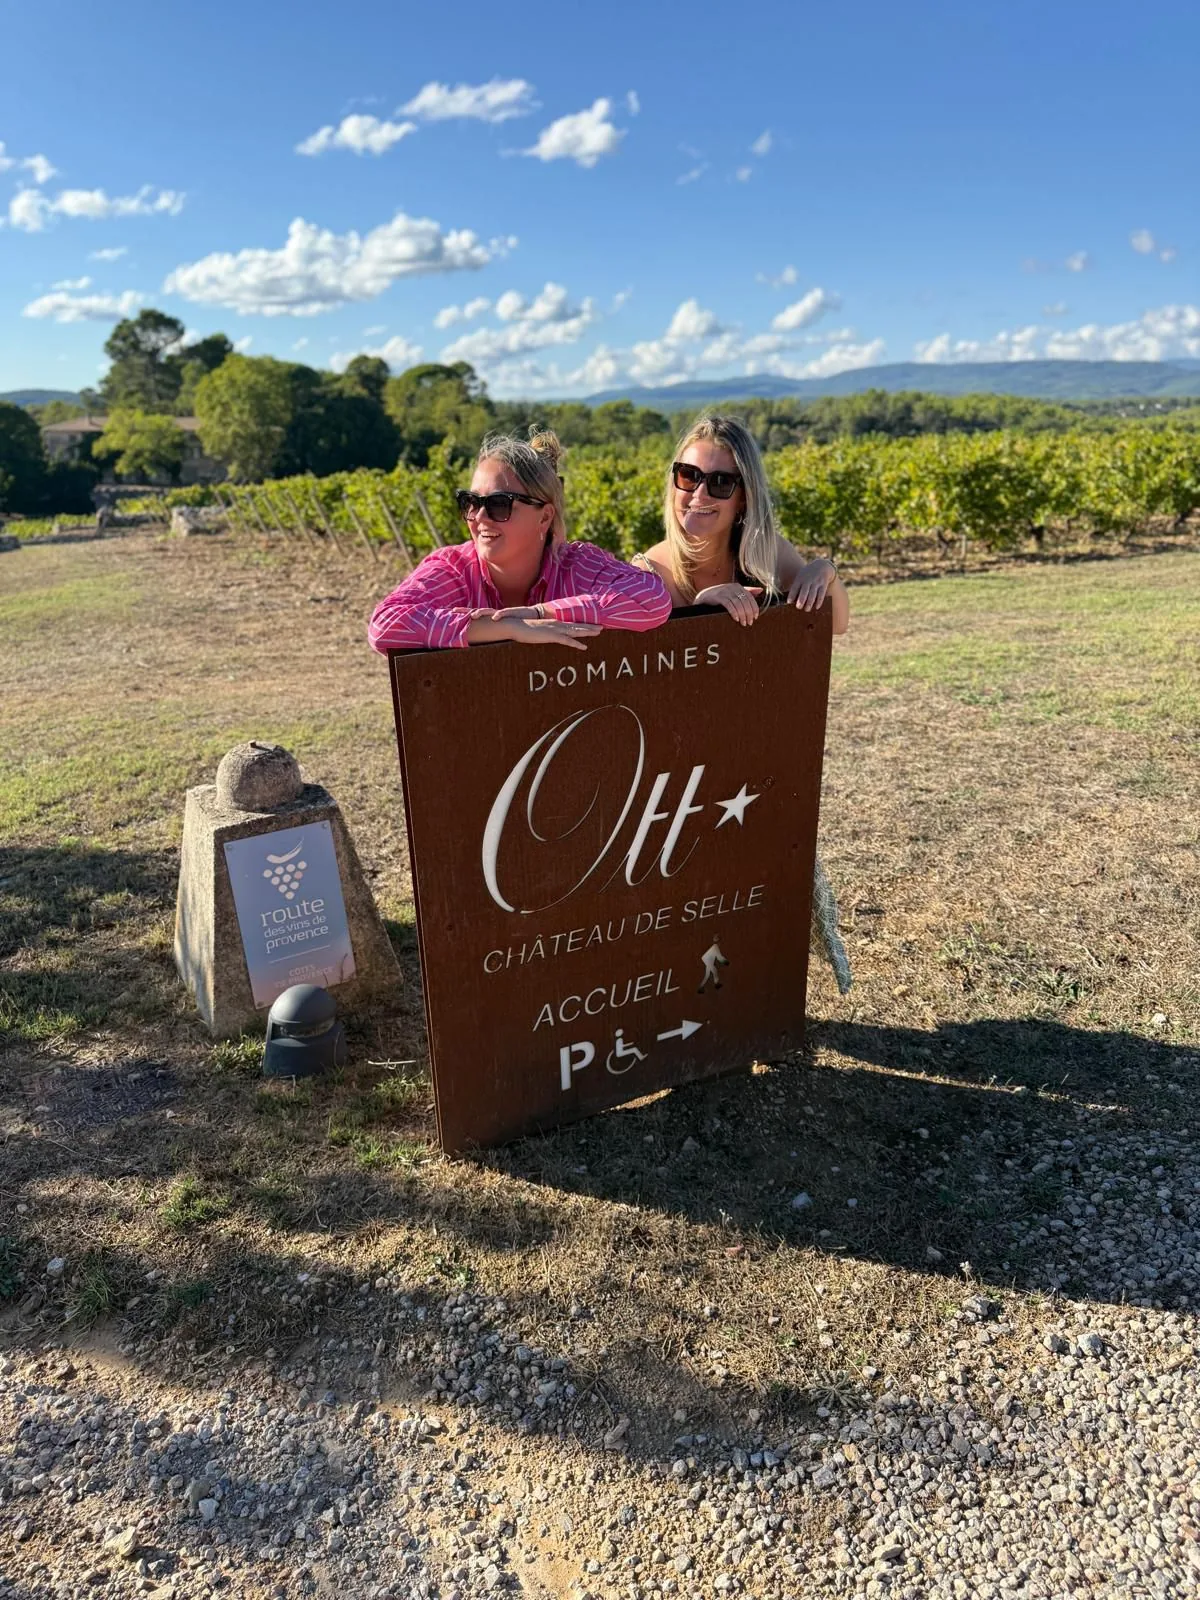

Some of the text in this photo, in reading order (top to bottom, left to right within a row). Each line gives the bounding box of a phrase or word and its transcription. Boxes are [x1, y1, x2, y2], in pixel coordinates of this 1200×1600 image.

[529, 644, 721, 691] DOMAINES
[481, 704, 705, 914] Ott
[260, 898, 324, 927] route
[264, 915, 326, 938] des vins de
[483, 884, 765, 974] CHÂTEAU DE SELLE
[266, 925, 329, 954] provence
[532, 968, 680, 1032] ACCUEIL
[559, 1041, 595, 1091] P
